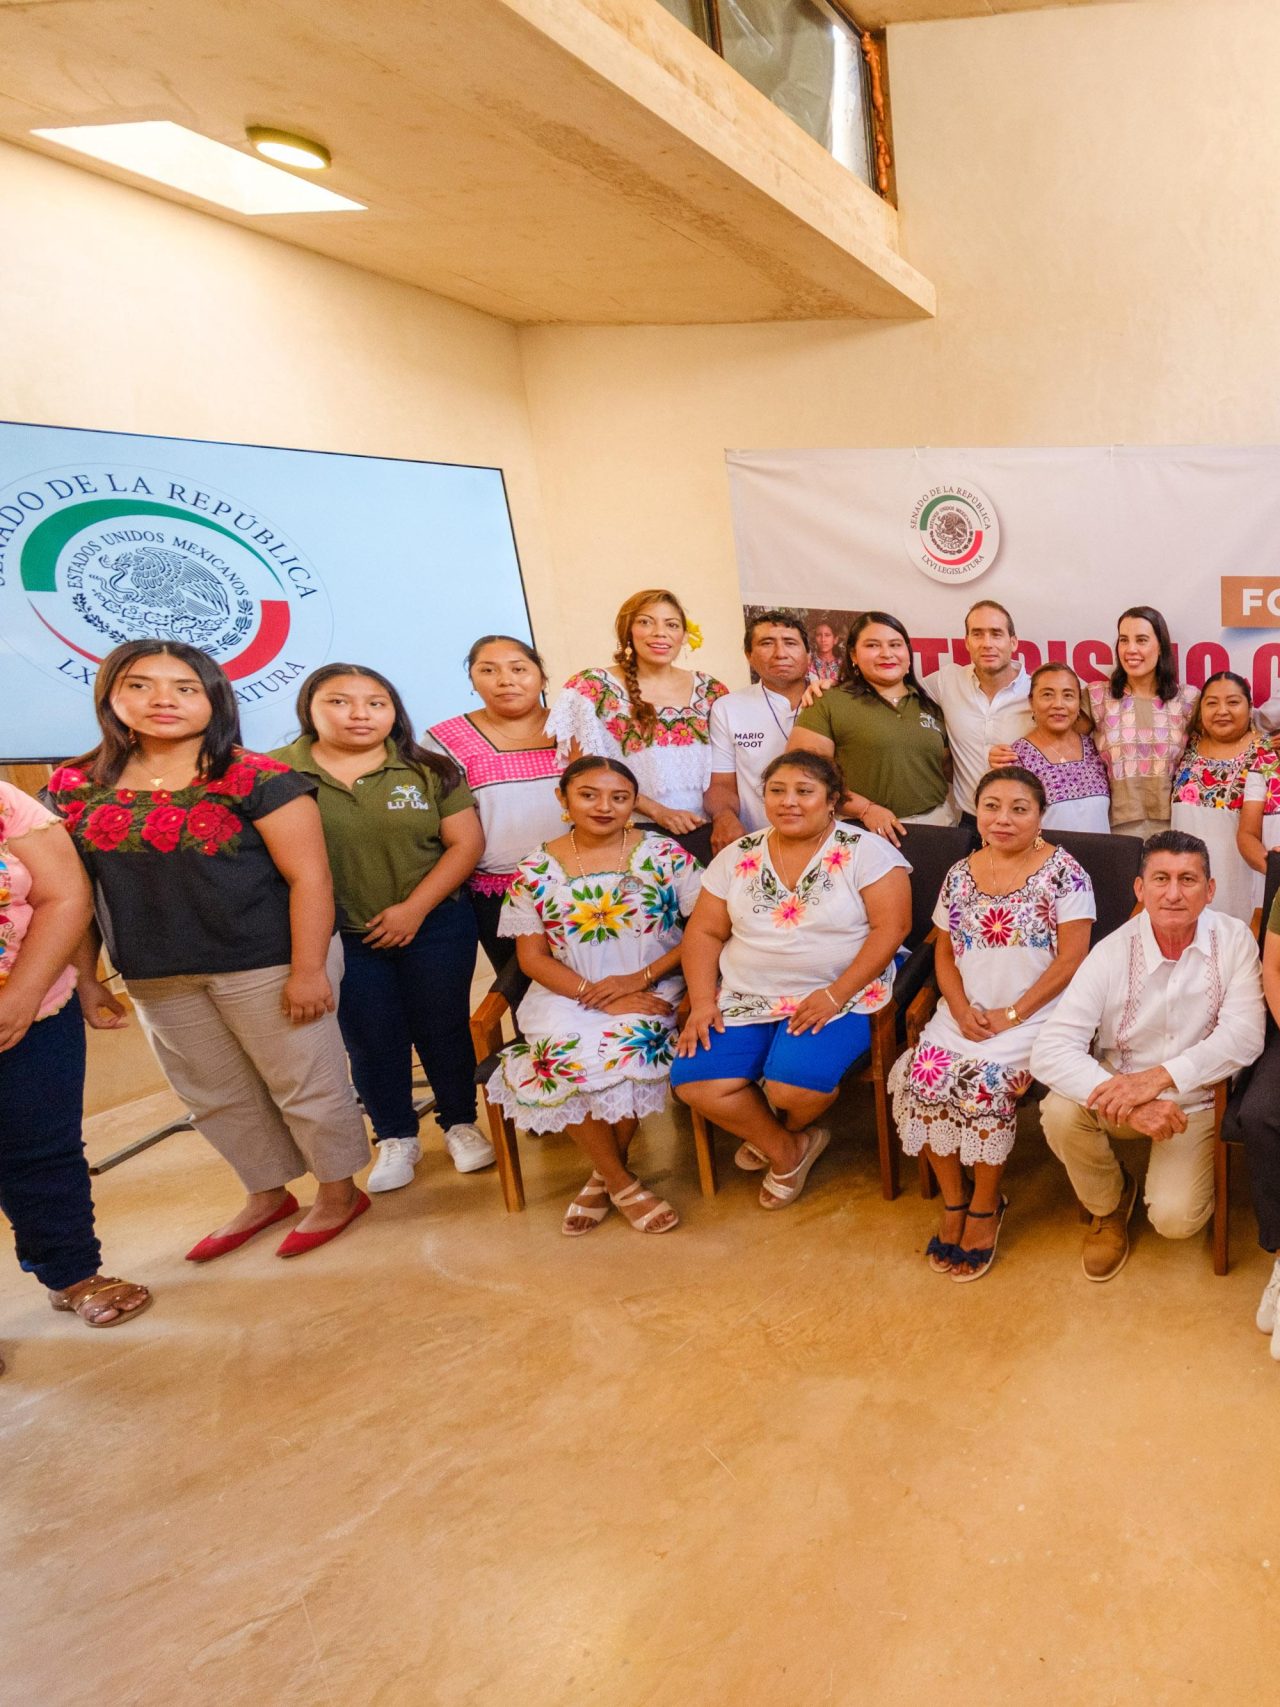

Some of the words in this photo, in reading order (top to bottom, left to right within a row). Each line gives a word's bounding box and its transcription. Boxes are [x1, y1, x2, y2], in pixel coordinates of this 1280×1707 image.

[910, 494, 929, 530] SENADO
[929, 486, 942, 497] DE
[943, 485, 955, 493] LA
[0, 491, 44, 586] ADO
[44, 474, 98, 500] DE
[104, 473, 155, 496] LA
[167, 481, 318, 600] REPÚBLICA
[67, 540, 102, 589] ESTADOS
[100, 530, 165, 546] UNIDOS
[172, 536, 249, 597] MEXICANOS
[734, 732, 765, 740] MARIO
